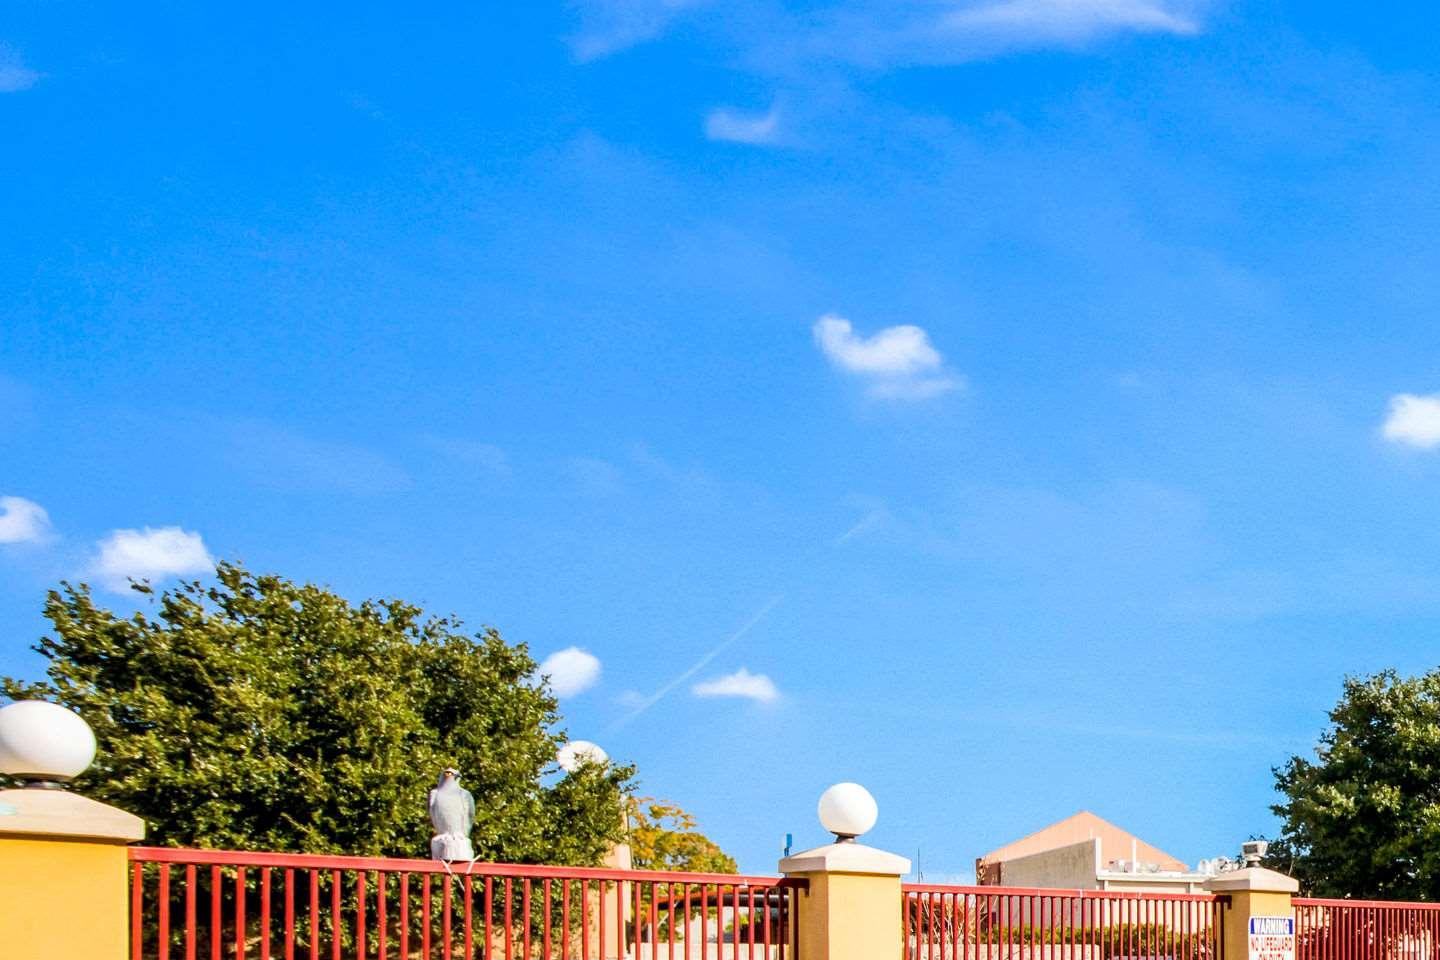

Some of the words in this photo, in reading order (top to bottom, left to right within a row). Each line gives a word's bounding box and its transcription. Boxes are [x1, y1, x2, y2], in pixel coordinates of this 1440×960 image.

[1255, 918, 1288, 934] WARNING
[1251, 937, 1259, 952] NO
[1260, 937, 1293, 952] LIFEGUARD
